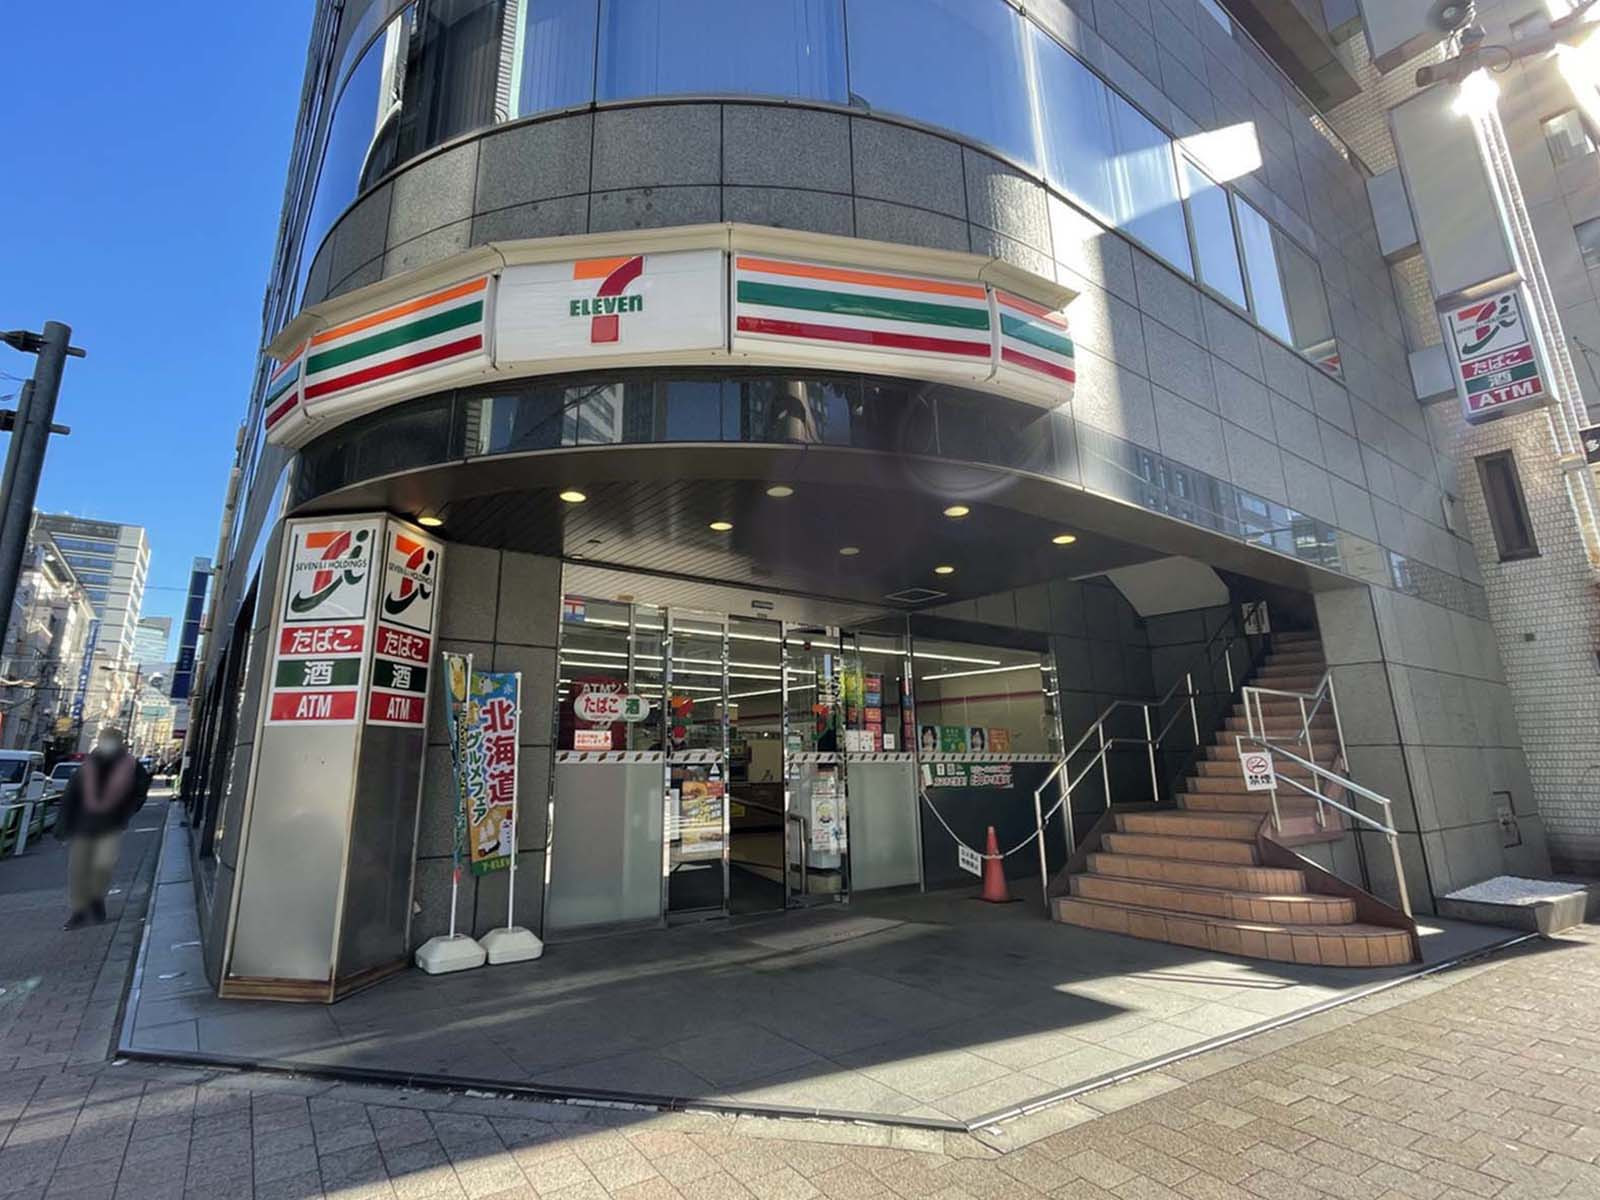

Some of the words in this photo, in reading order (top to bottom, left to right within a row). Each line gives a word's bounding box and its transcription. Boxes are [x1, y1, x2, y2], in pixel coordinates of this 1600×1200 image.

[1471, 351, 1523, 375] たばこ
[1488, 370, 1512, 387] 酒
[1479, 381, 1534, 407] ATM
[295, 562, 317, 572] SEVEN
[328, 559, 367, 570] HOLDINGS
[291, 629, 351, 652] たばこ
[385, 632, 424, 659] たばこ
[302, 661, 334, 686] 酒
[392, 664, 412, 689] 酒
[296, 694, 332, 717] ATM
[387, 697, 410, 720] ATM
[583, 697, 619, 714] たばこ
[625, 698, 641, 714] 酒
[482, 699, 515, 805] 北海道
[466, 730, 487, 826] グルメフェア
